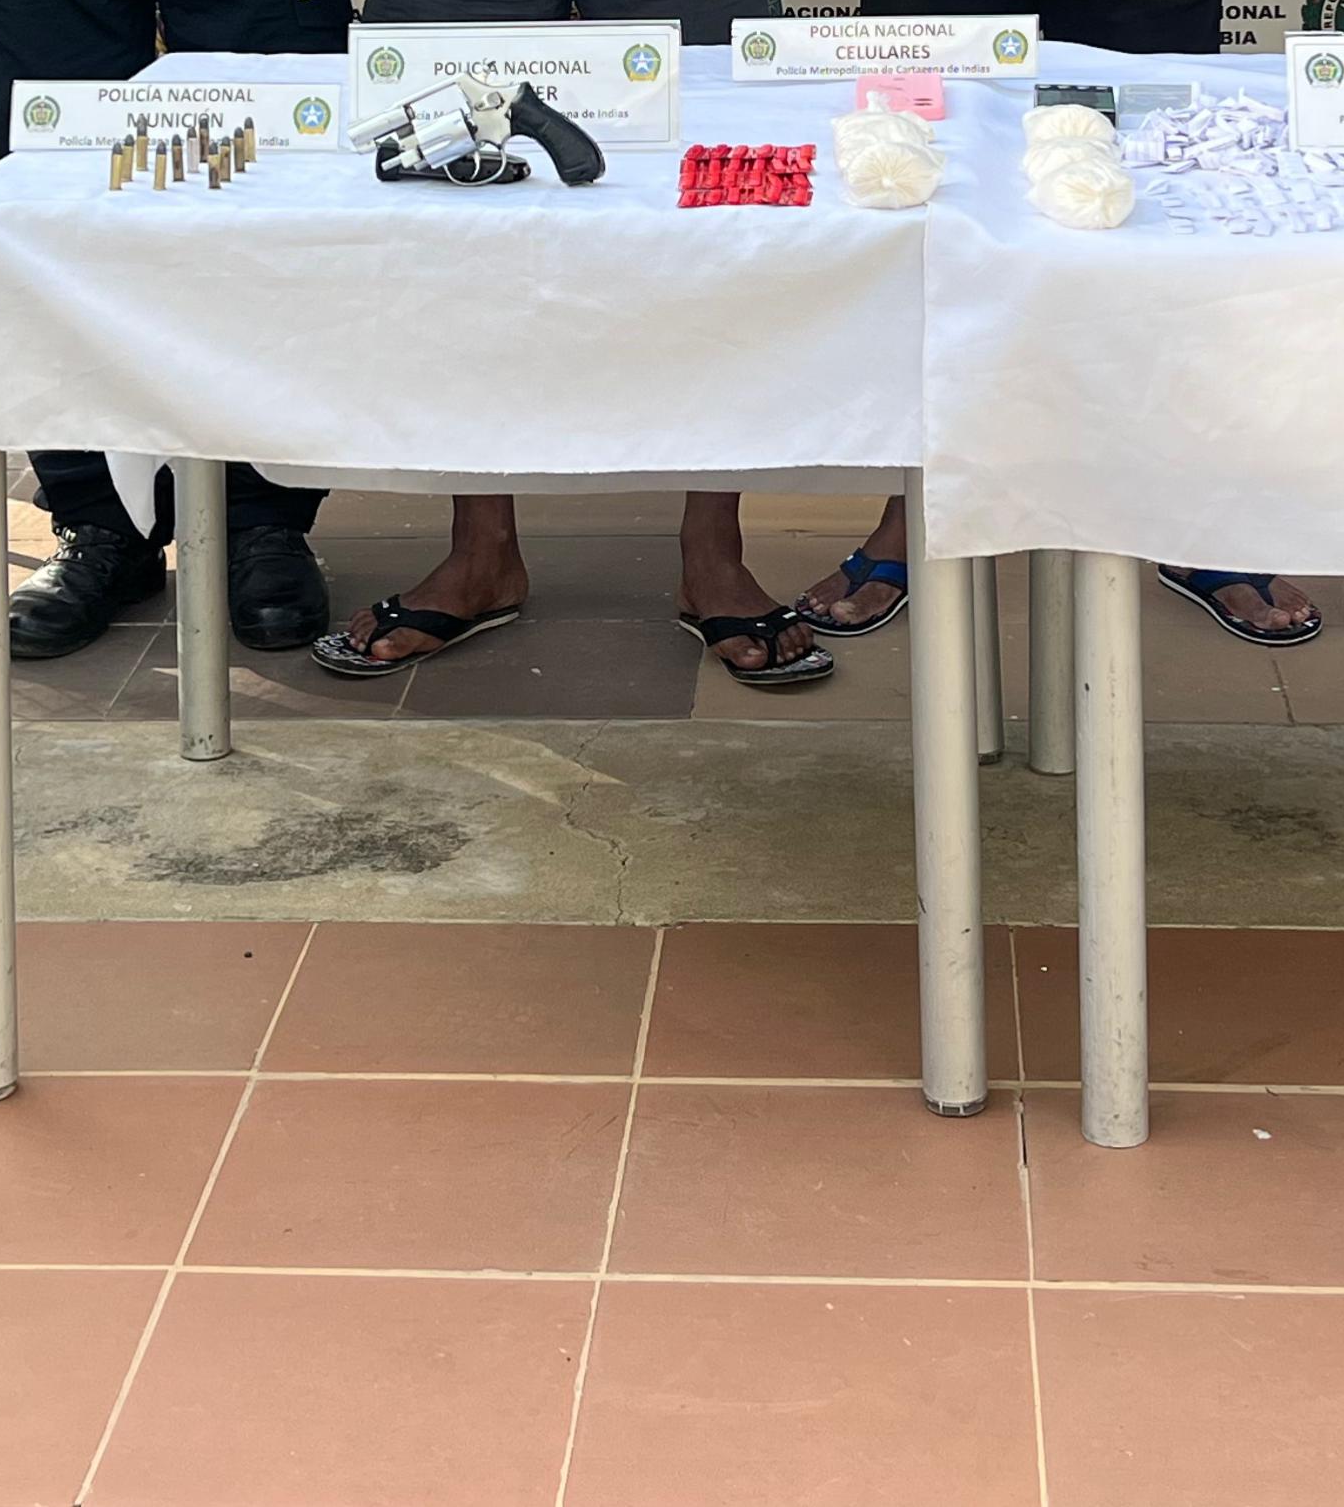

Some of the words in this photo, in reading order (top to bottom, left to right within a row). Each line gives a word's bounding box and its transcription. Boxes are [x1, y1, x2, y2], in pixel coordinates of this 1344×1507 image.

[810, 22, 870, 38] POLICÍA
[874, 23, 956, 38] NACIONAL
[835, 44, 931, 61] CELULARES
[504, 60, 591, 75] NACIONAL
[776, 65, 807, 76] Policía
[810, 65, 879, 77] Metropolitana
[881, 65, 894, 75] de
[949, 64, 960, 74] de
[961, 63, 991, 74] Indias
[98, 85, 163, 103] POLICÍA
[168, 87, 256, 103] NACIONAL
[582, 108, 595, 119] de
[597, 108, 629, 119] Indias
[59, 134, 93, 147] Policía
[258, 136, 290, 147] Indias
